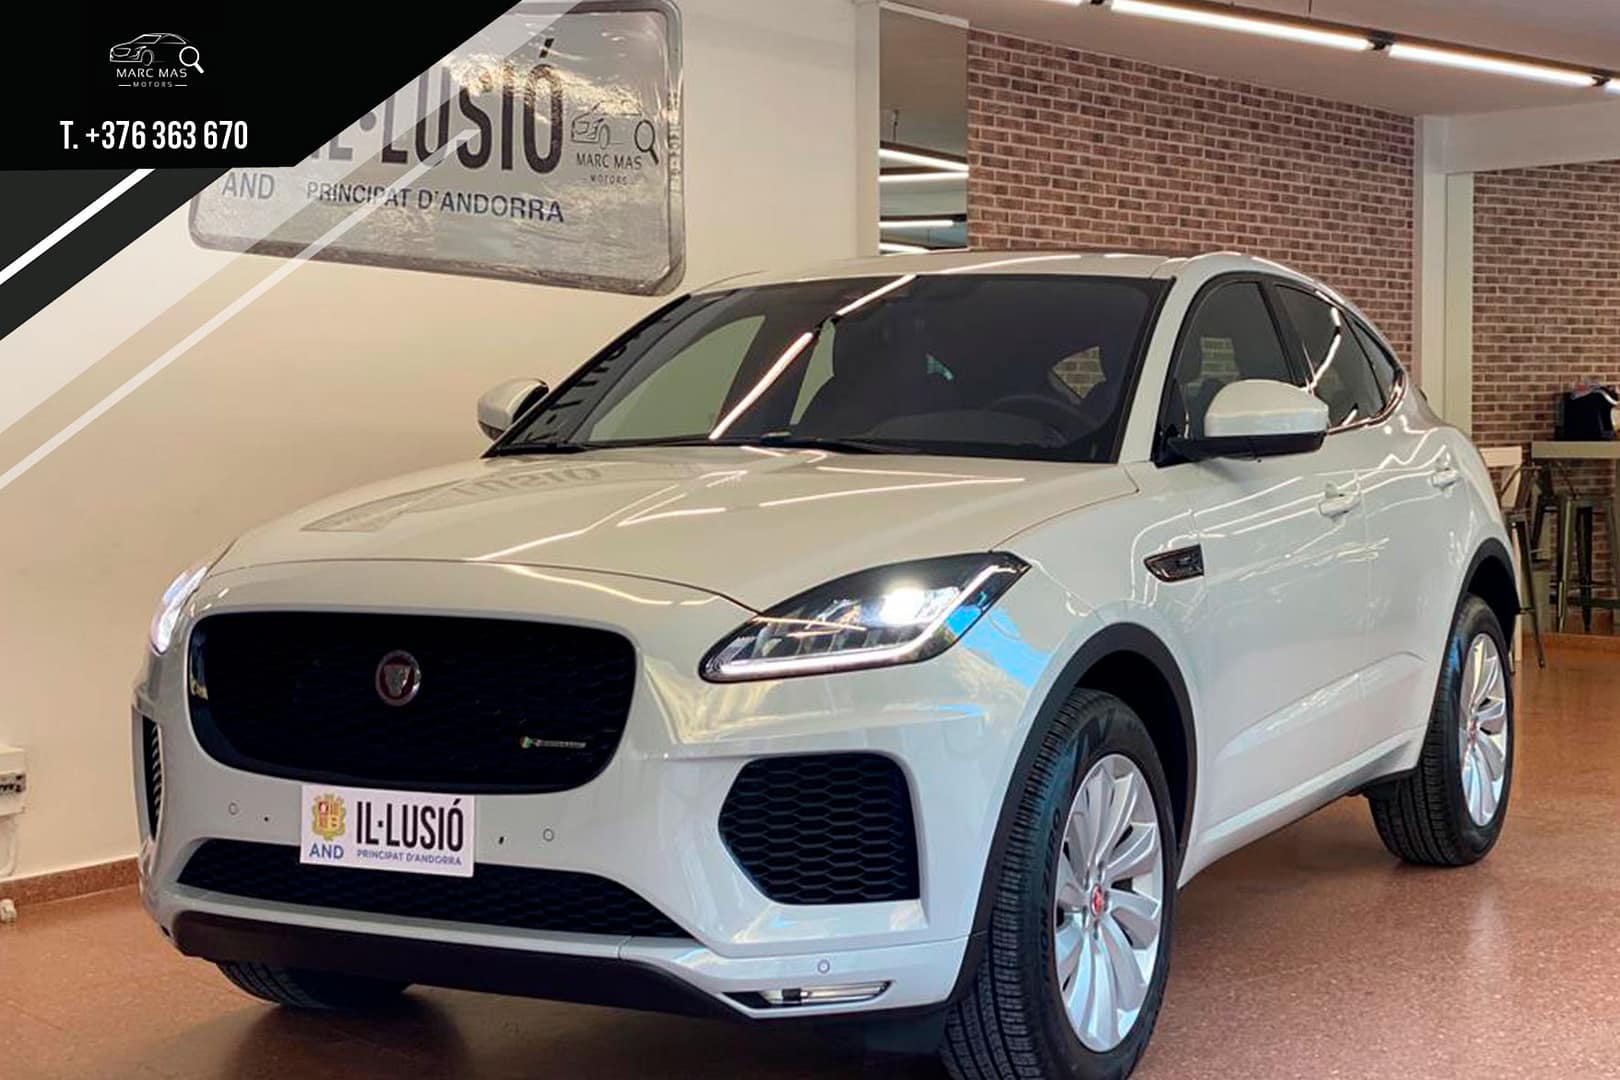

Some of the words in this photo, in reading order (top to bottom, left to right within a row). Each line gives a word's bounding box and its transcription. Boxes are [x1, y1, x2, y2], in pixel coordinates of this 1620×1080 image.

[576, 152, 609, 168] MARC
[614, 154, 642, 169] MAS
[222, 171, 275, 200] AND
[307, 181, 411, 208] PRINCIPAT
[417, 189, 564, 223] D'ANDORRA
[356, 798, 464, 852] IL·LUSIÓ
[309, 844, 344, 860] AND
[357, 850, 403, 863] PRINCIPAT
[406, 852, 462, 866] D'ANDORRA
